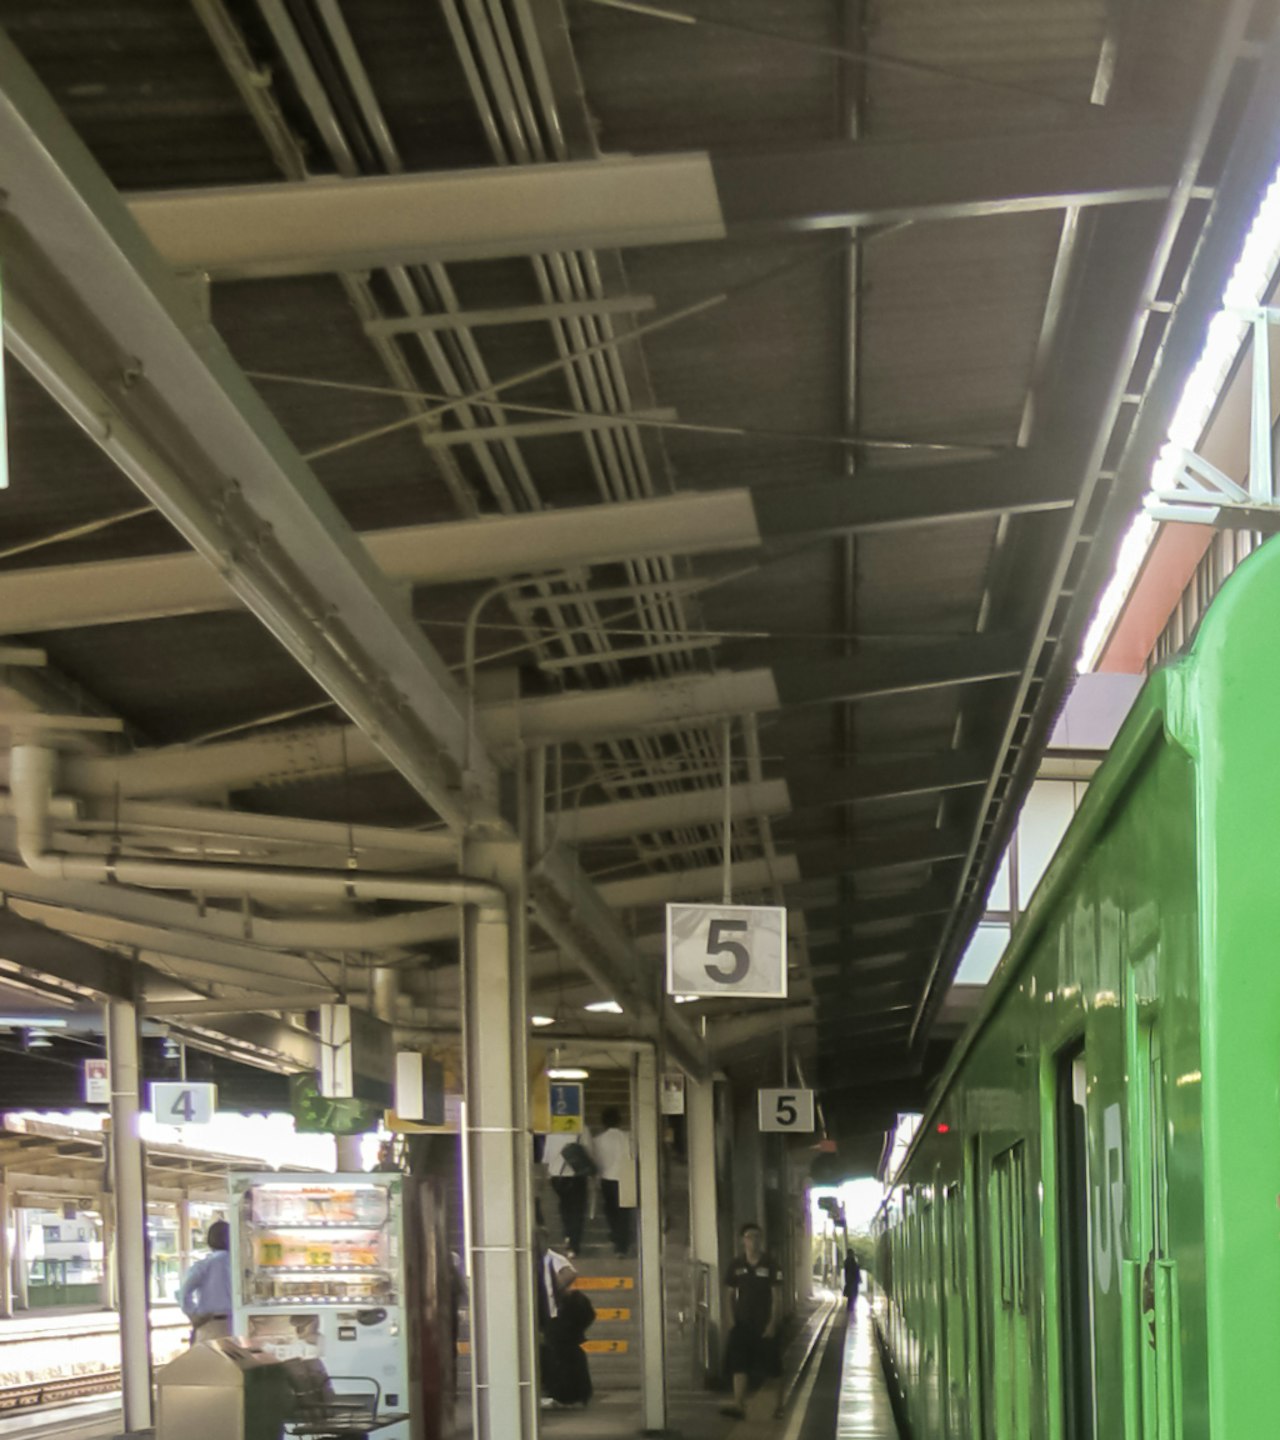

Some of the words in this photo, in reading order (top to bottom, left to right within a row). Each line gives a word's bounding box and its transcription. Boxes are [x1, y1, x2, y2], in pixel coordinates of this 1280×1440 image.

[703, 919, 751, 985] 5
[170, 1089, 196, 1122] 4
[775, 1095, 798, 1126] 5
[1094, 1102, 1124, 1295] JR
